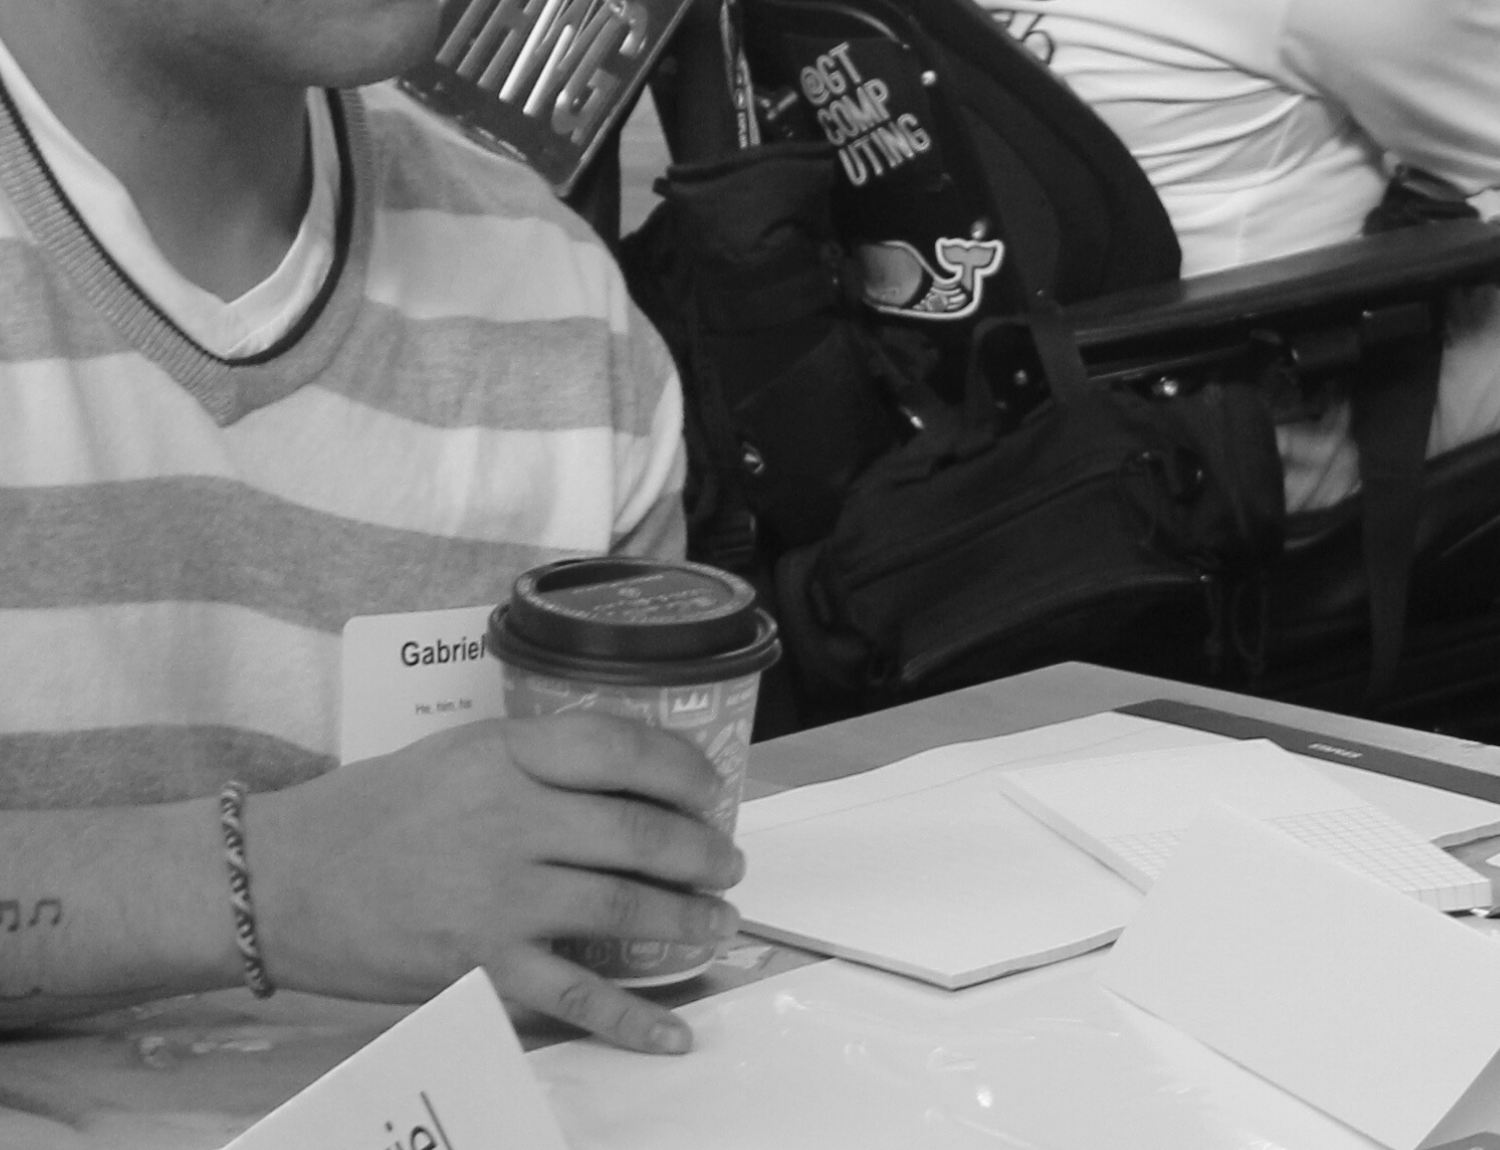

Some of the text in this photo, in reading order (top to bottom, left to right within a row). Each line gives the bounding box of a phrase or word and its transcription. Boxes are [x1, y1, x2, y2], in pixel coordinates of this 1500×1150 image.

[800, 40, 863, 106] @GT
[816, 77, 891, 147] COMP
[838, 112, 932, 187] UTING
[400, 635, 485, 669] Gabriel
